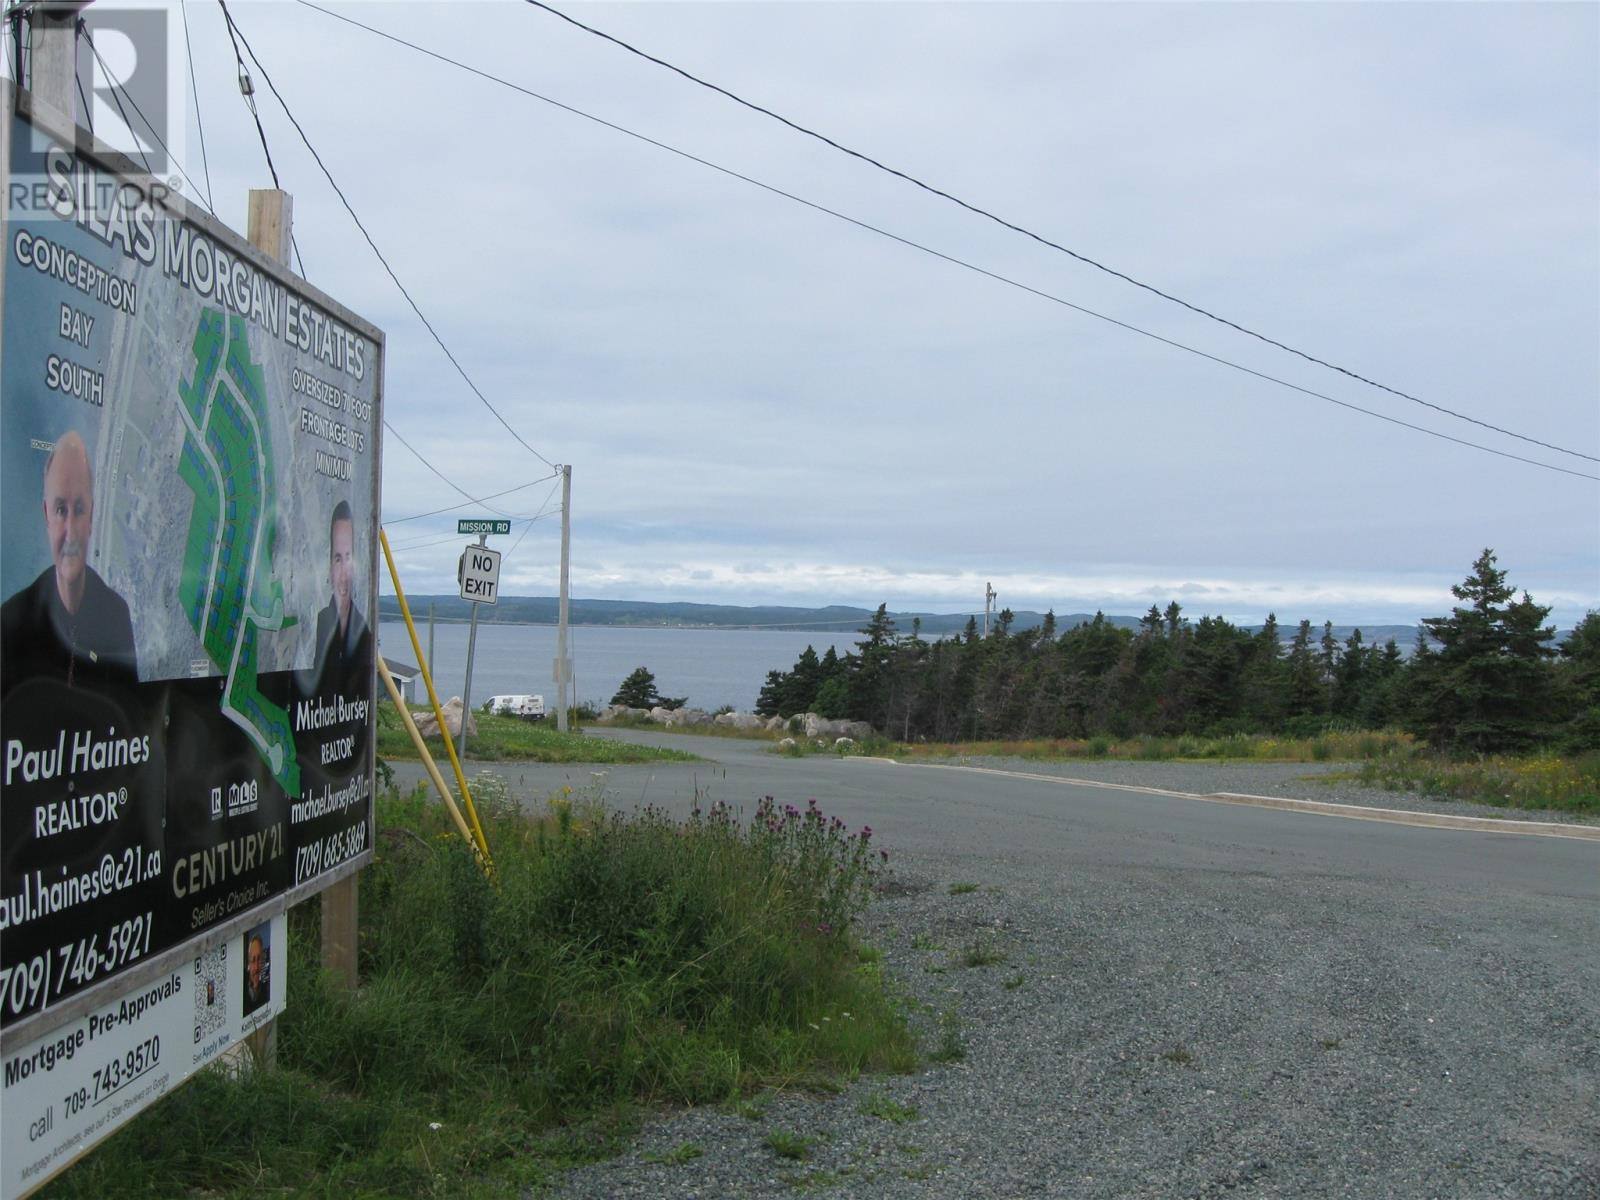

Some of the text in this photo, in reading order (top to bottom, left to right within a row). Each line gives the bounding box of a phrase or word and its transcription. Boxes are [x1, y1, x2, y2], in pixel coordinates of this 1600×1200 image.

[15, 231, 137, 313] CONCEPTION
[46, 146, 366, 380] SILAS MORGAN ESTATES
[60, 305, 94, 347] BAY
[47, 356, 103, 405] SOUTH
[292, 368, 341, 408] OVERSIZED
[351, 398, 371, 421] FOOT
[301, 409, 347, 444] FRONTAGE
[459, 522, 508, 532] MISSION RD
[465, 578, 495, 597] EXIT
[472, 554, 493, 573] NO
[296, 694, 370, 731] Michael Bursey
[6, 726, 150, 785] Paul Haines
[35, 787, 128, 838] REALTOR®
[173, 822, 282, 898] CENTURY 21
[295, 820, 366, 886] (709) 685-5869
[0, 845, 161, 930] aul.haines@c21.ca
[191, 898, 225, 929] Seller's
[226, 887, 255, 913] Choice
[56, 911, 153, 994] 746-5921
[5, 1029, 84, 1089] Mortgage
[89, 974, 182, 1040] Pre-Approvals
[29, 1105, 53, 1142] call
